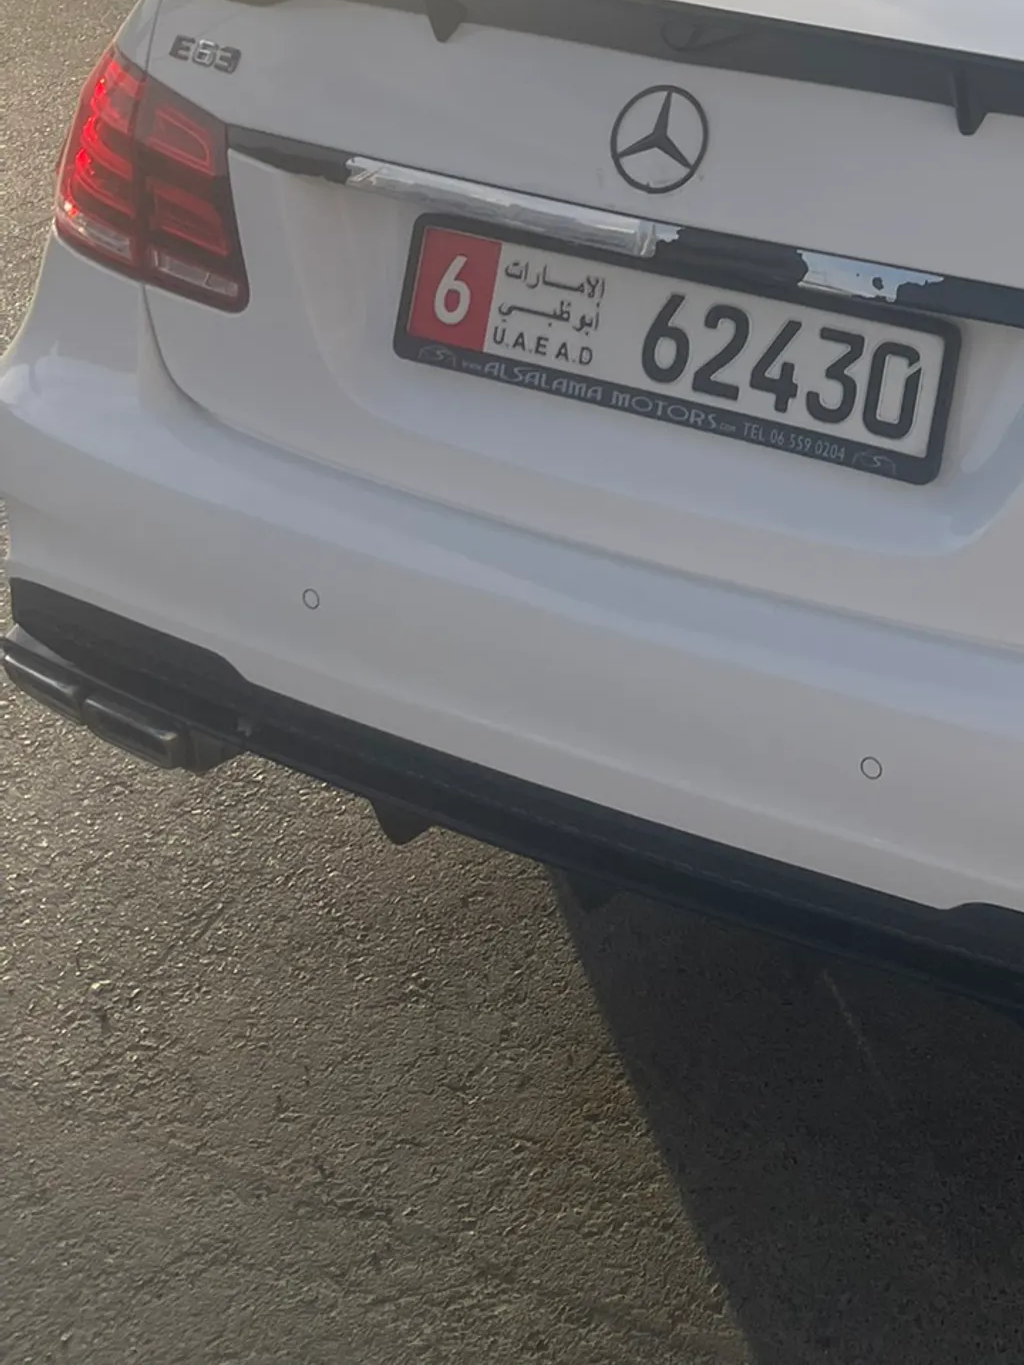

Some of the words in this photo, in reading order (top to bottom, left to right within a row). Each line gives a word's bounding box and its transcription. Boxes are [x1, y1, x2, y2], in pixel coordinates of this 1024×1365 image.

[168, 34, 242, 74] E63
[433, 254, 472, 326] 6
[640, 293, 923, 440] 62430
[743, 422, 766, 442] TEL
[770, 429, 785, 446] 06
[788, 434, 812, 452] 559
[814, 440, 846, 461] 0204
